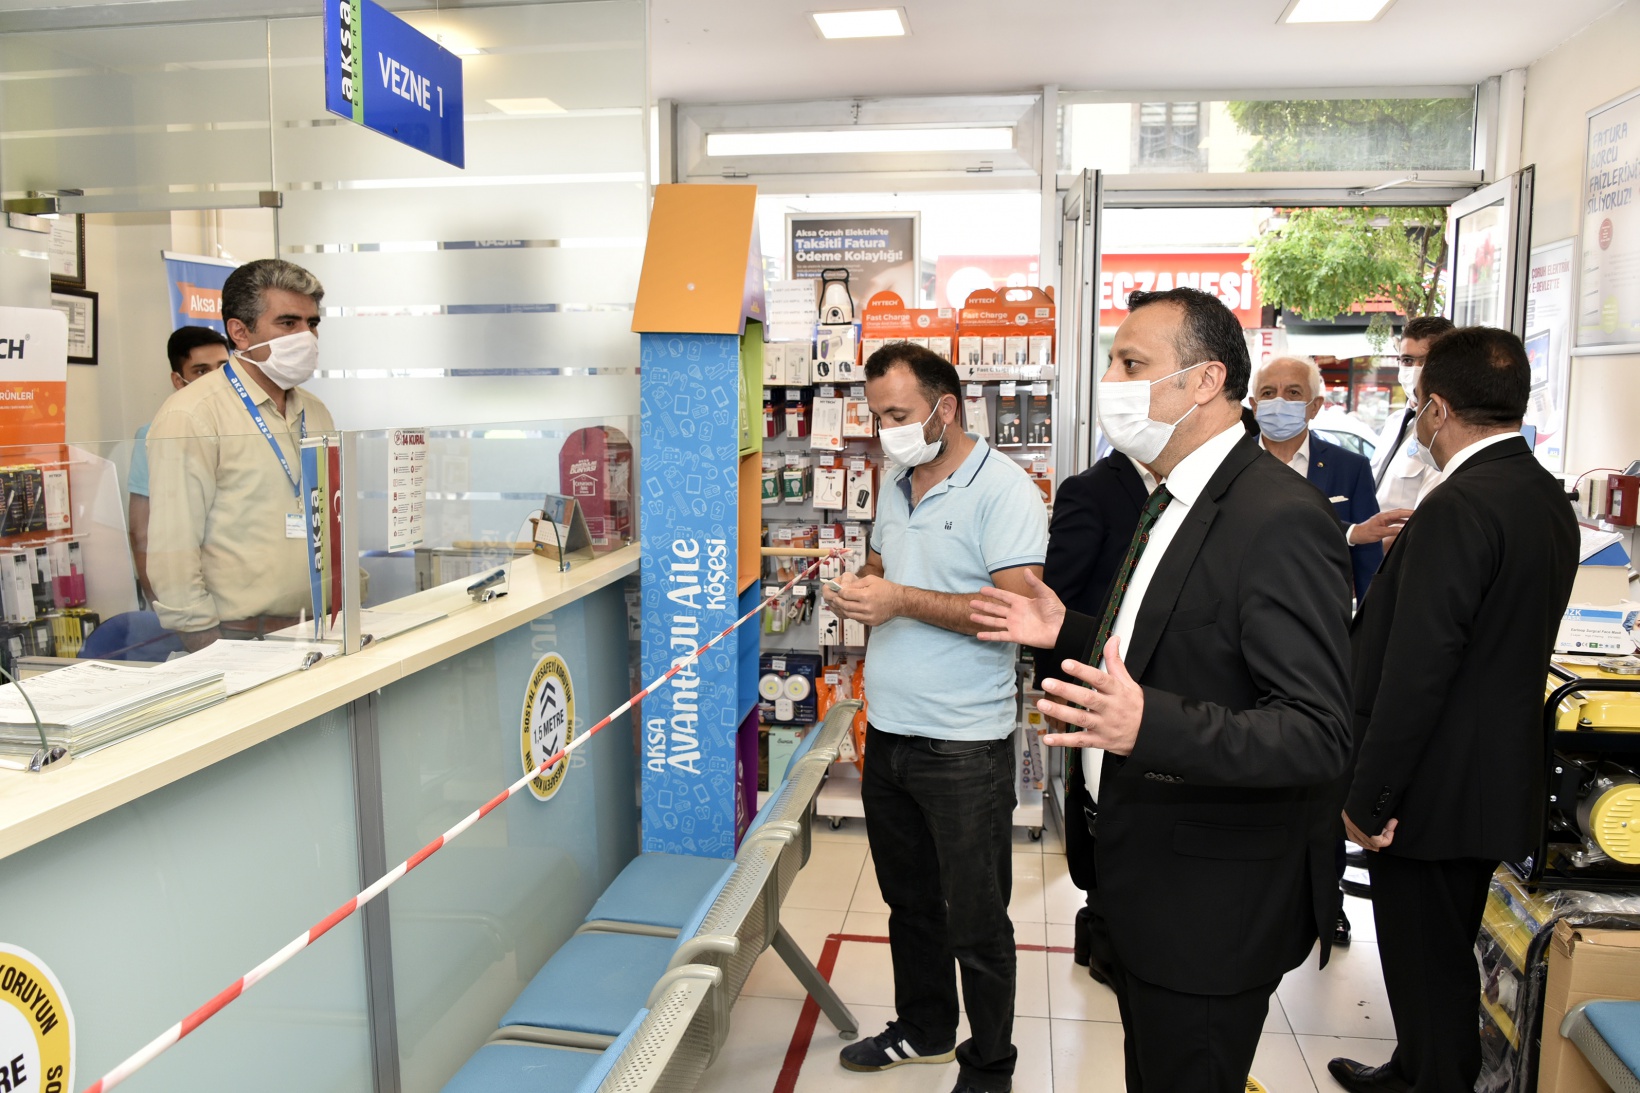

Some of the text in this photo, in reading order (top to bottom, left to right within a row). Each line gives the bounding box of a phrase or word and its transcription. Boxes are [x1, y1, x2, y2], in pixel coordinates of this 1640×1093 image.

[339, 1, 353, 100] aksa
[378, 51, 443, 118] VEZNE 1
[1593, 121, 1628, 149] FATURA
[1590, 145, 1618, 170] BORCU
[1587, 186, 1632, 215] SİLİYORUZ!
[795, 229, 817, 237] Aksa
[818, 228, 844, 238] Çoruh
[795, 237, 886, 249] Taksitli Fatura
[795, 249, 903, 263] Ödeme Kolaylığı!
[1531, 265, 1547, 281] ÇORUH
[190, 294, 216, 313] Aksa
[979, 312, 1008, 320] Charge
[883, 313, 911, 322] Charge
[230, 377, 248, 399] aksa
[254, 416, 273, 439] aksa
[310, 489, 322, 571] aksa
[523, 690, 536, 734] SOSYAL
[533, 726, 543, 745] 1,5
[543, 709, 564, 737] METRE
[647, 717, 667, 773] AKSA
[0, 964, 59, 1037] ORUYUN
